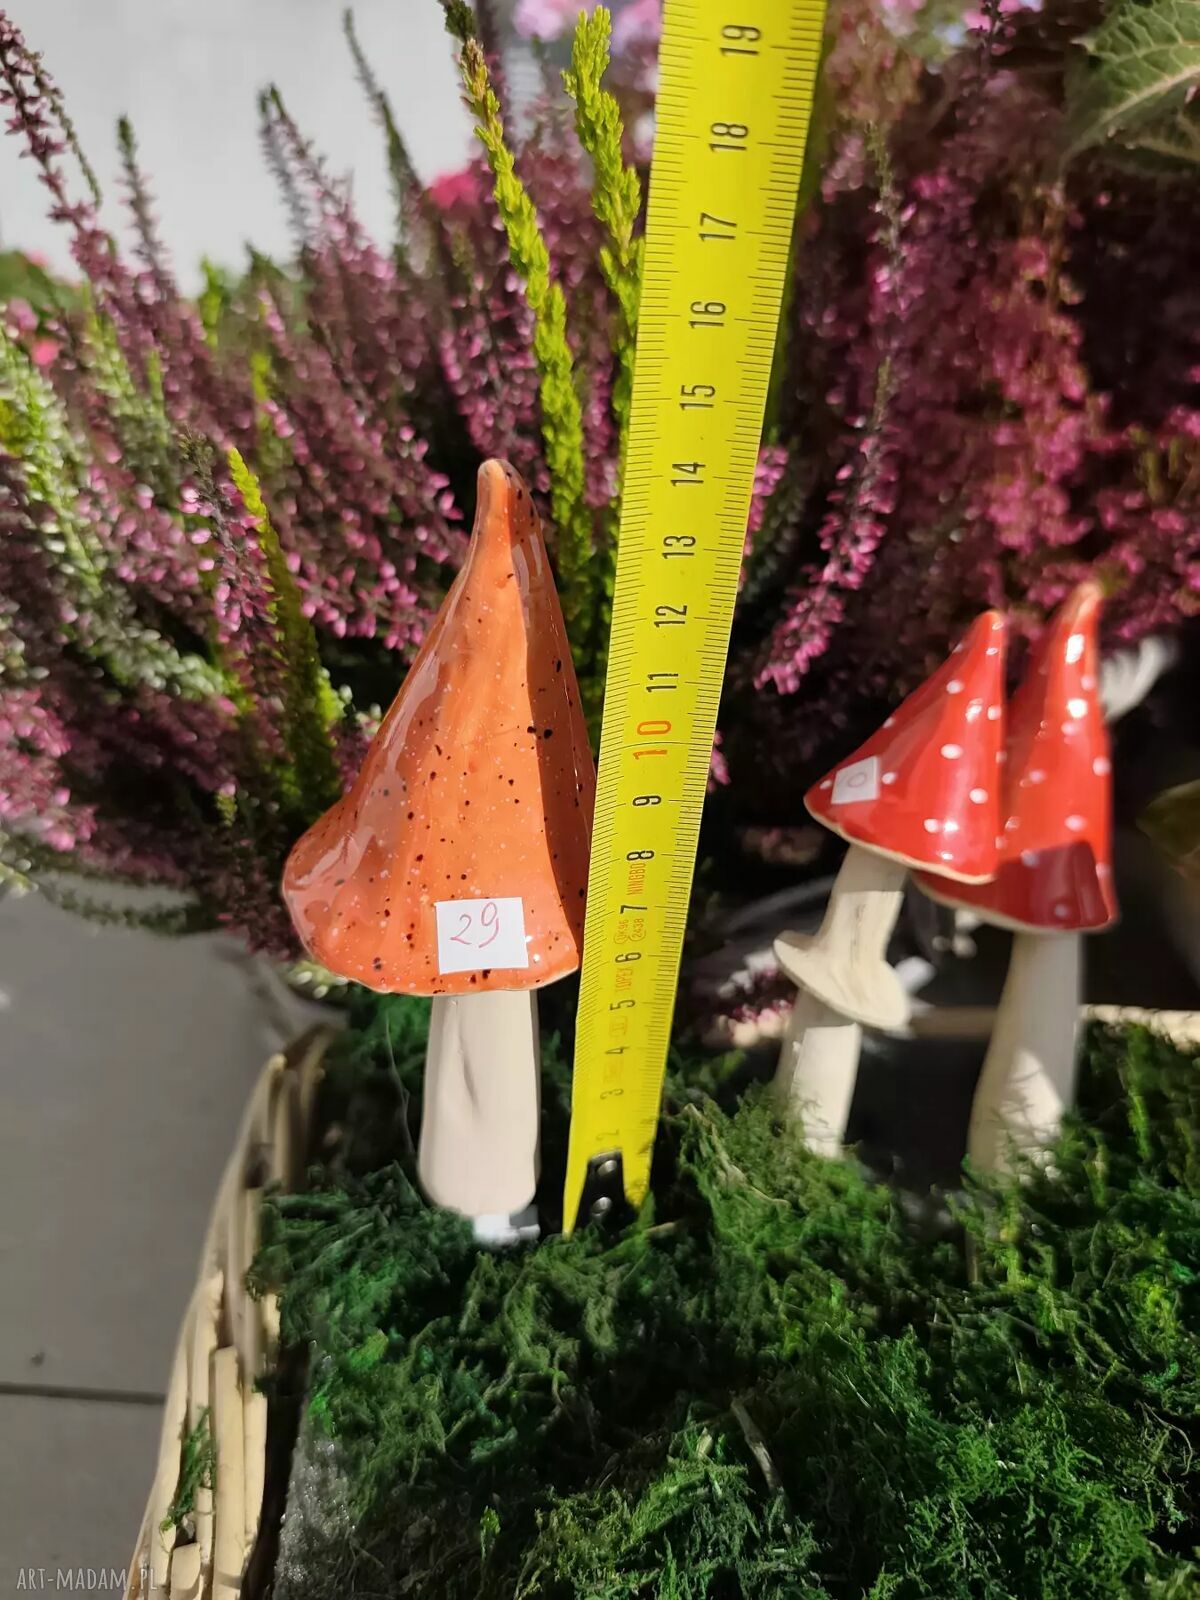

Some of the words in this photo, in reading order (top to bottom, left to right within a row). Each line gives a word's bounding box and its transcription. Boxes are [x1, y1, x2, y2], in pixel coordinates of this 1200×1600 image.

[720, 24, 761, 56] 19
[708, 122, 749, 152] 18
[698, 211, 738, 242] 17
[688, 301, 726, 329] 16
[679, 384, 716, 411] 15
[670, 462, 706, 487] 14
[661, 535, 696, 559] 13
[653, 604, 688, 628] 12
[645, 672, 679, 693] 11
[632, 720, 672, 760] 10
[632, 795, 662, 807] 9
[626, 849, 655, 861] 8
[619, 904, 648, 914] 7
[450, 902, 499, 949] 29
[615, 951, 642, 963] 6
[609, 999, 636, 1011] 5
[604, 1045, 631, 1055] 4
[599, 1087, 625, 1100] 3
